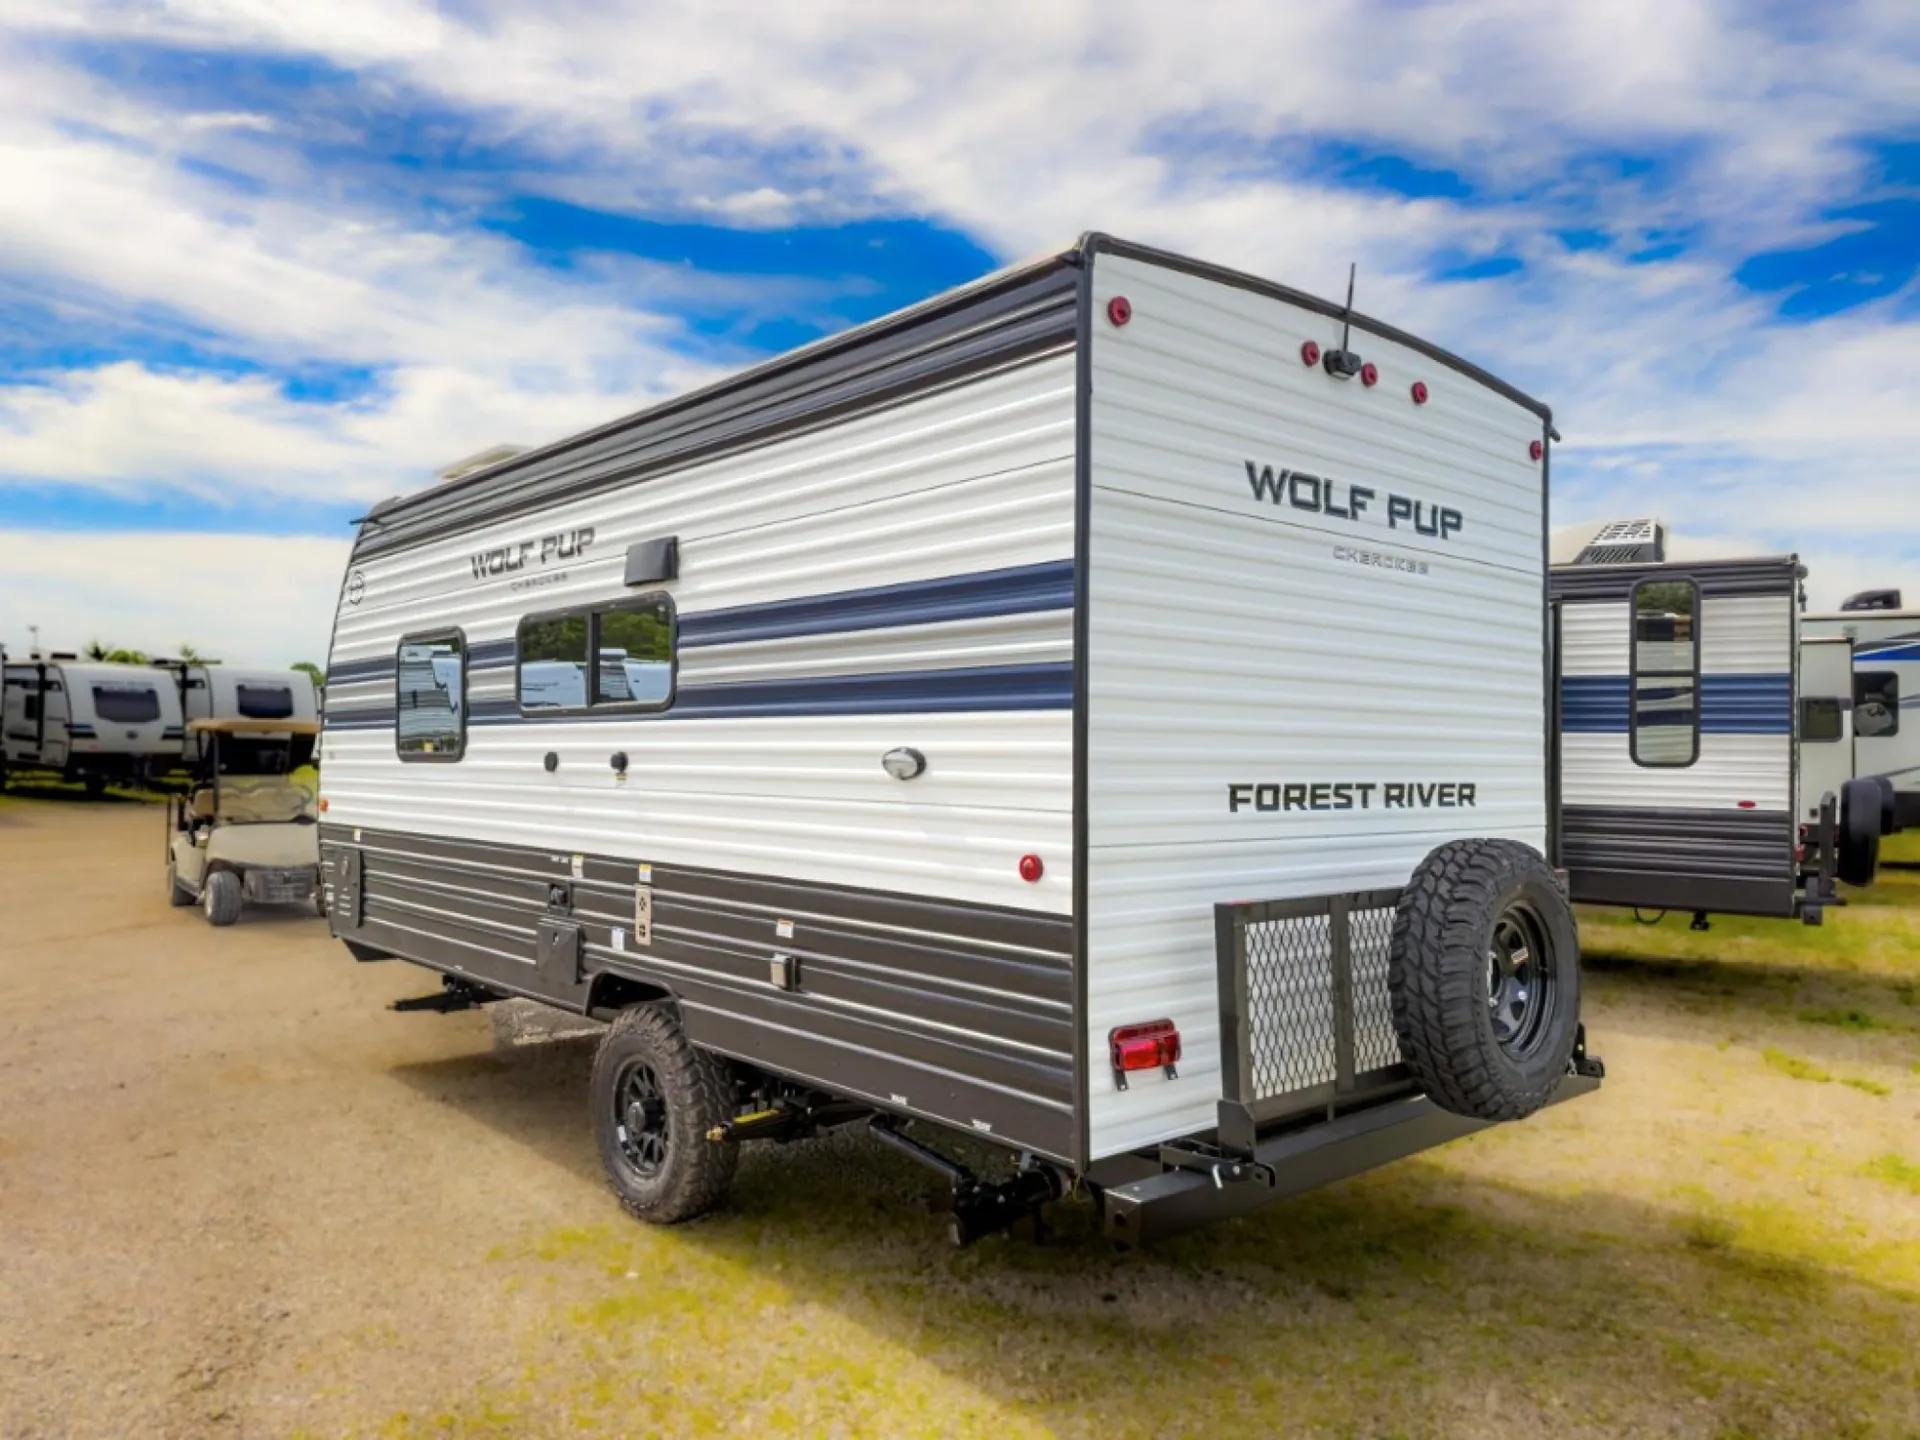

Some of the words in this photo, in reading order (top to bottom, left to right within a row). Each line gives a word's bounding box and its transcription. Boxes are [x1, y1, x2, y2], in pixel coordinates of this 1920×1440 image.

[1244, 459, 1376, 521] WOLF
[1387, 493, 1464, 540] PUP
[471, 541, 535, 580] WOLF
[541, 527, 595, 565] PUP
[1228, 782, 1377, 813] FOREST
[1384, 782, 1477, 809] RIVER
